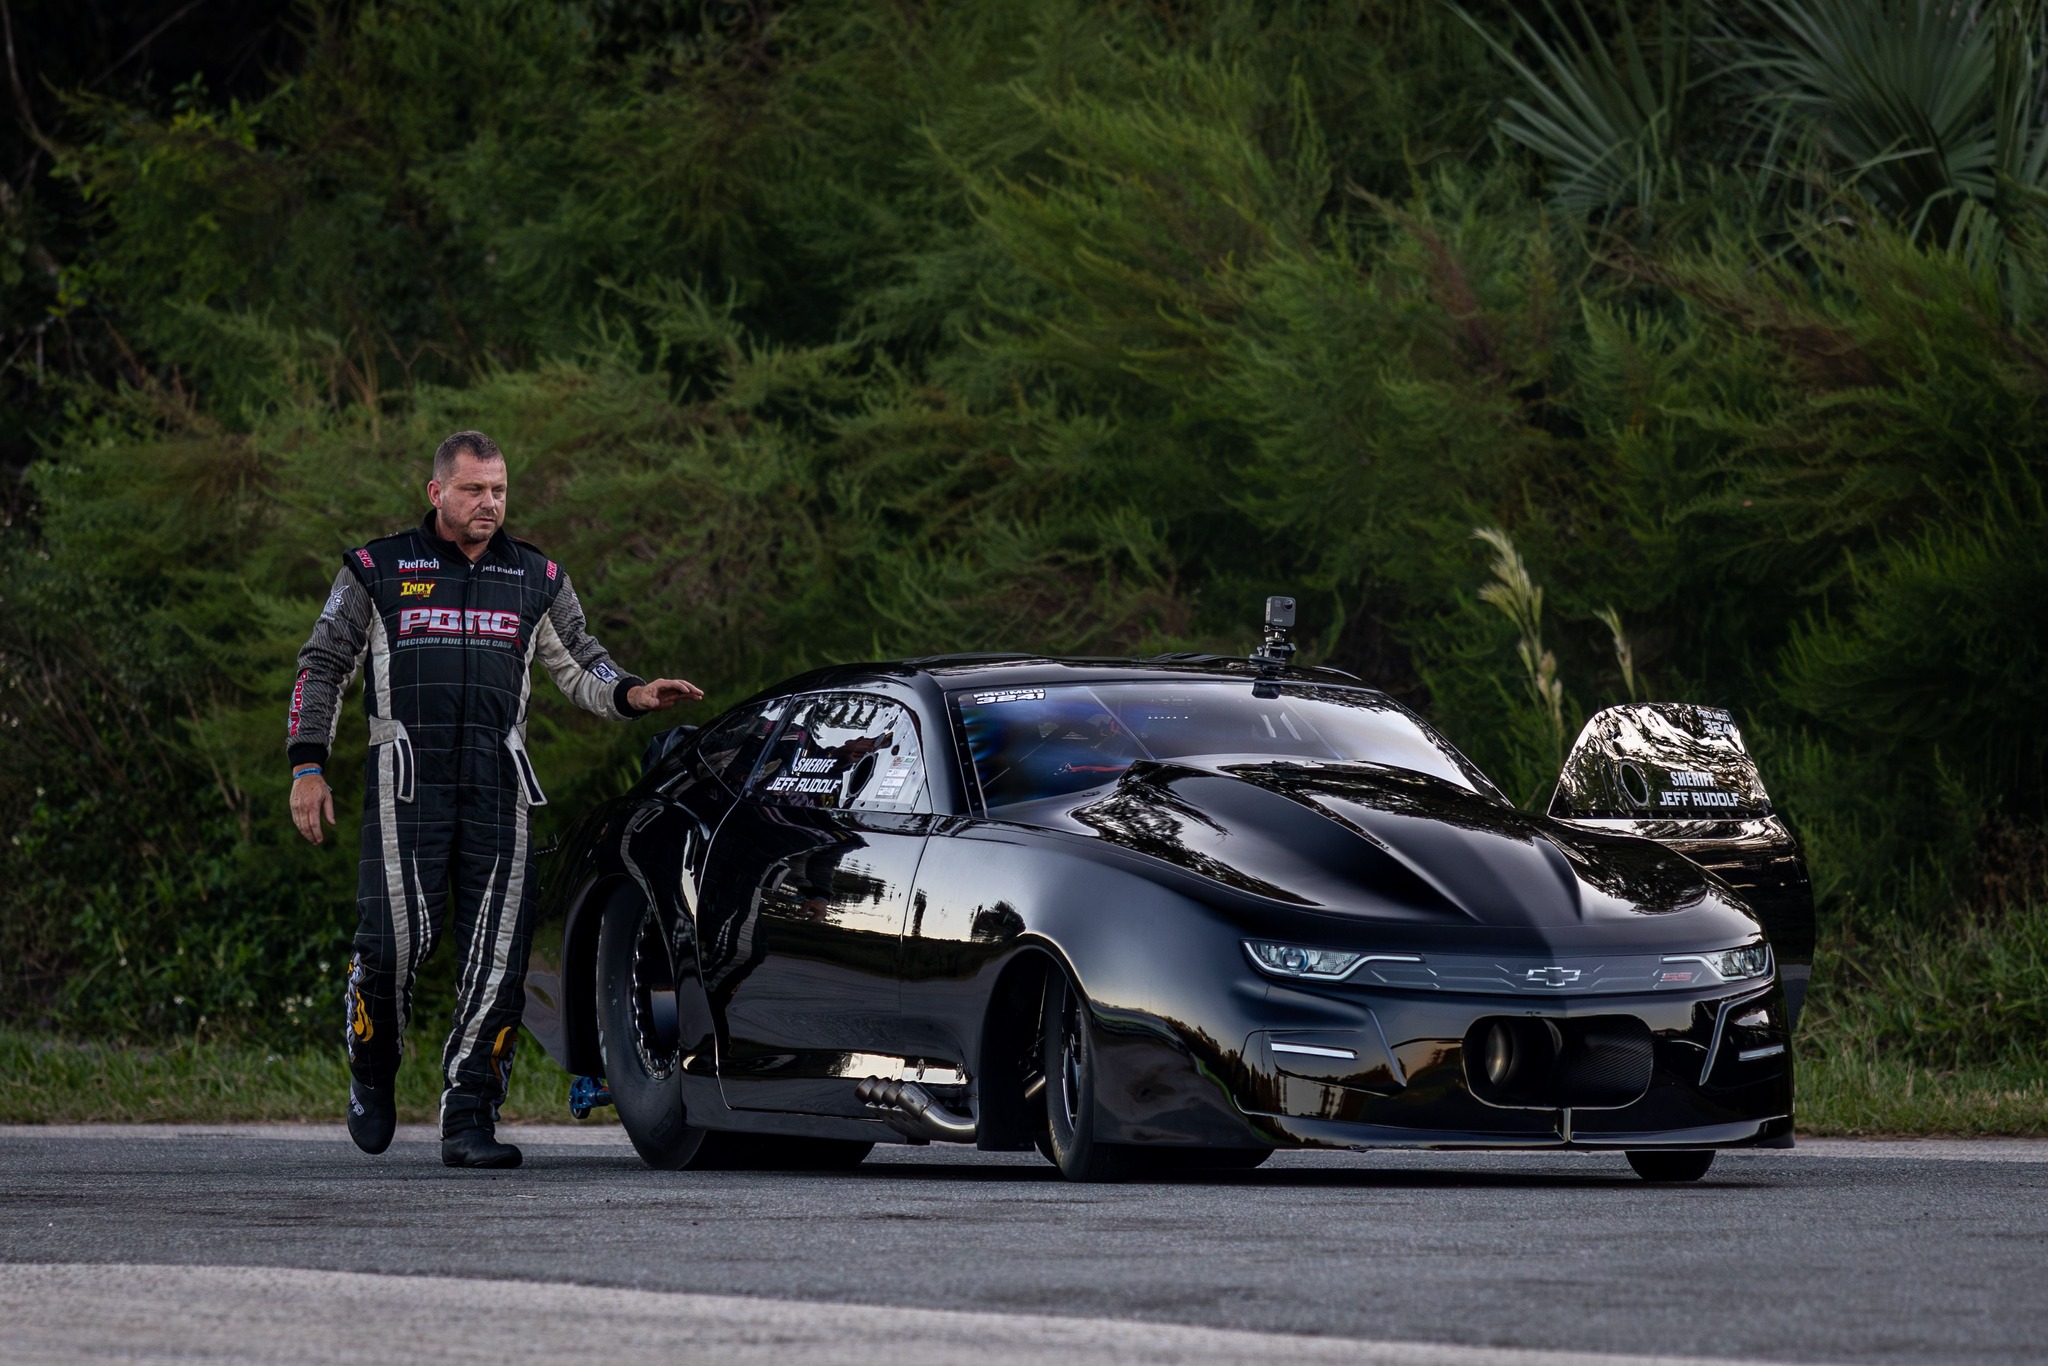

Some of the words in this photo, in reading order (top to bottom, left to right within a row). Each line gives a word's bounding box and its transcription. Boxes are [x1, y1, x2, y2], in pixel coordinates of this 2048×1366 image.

[398, 558, 440, 570] FuelTech
[481, 565, 496, 573] Jeff
[497, 566, 525, 576] Rudolf
[399, 607, 520, 637] PBRC
[397, 636, 441, 648] PRECISION
[793, 757, 838, 773] SHERIFF
[766, 777, 799, 791] JEFF
[794, 778, 842, 793] RUDOLF
[1669, 771, 1715, 787] SHERIFF
[1659, 791, 1690, 806] JEFF
[1691, 792, 1740, 807] RUDOLF
